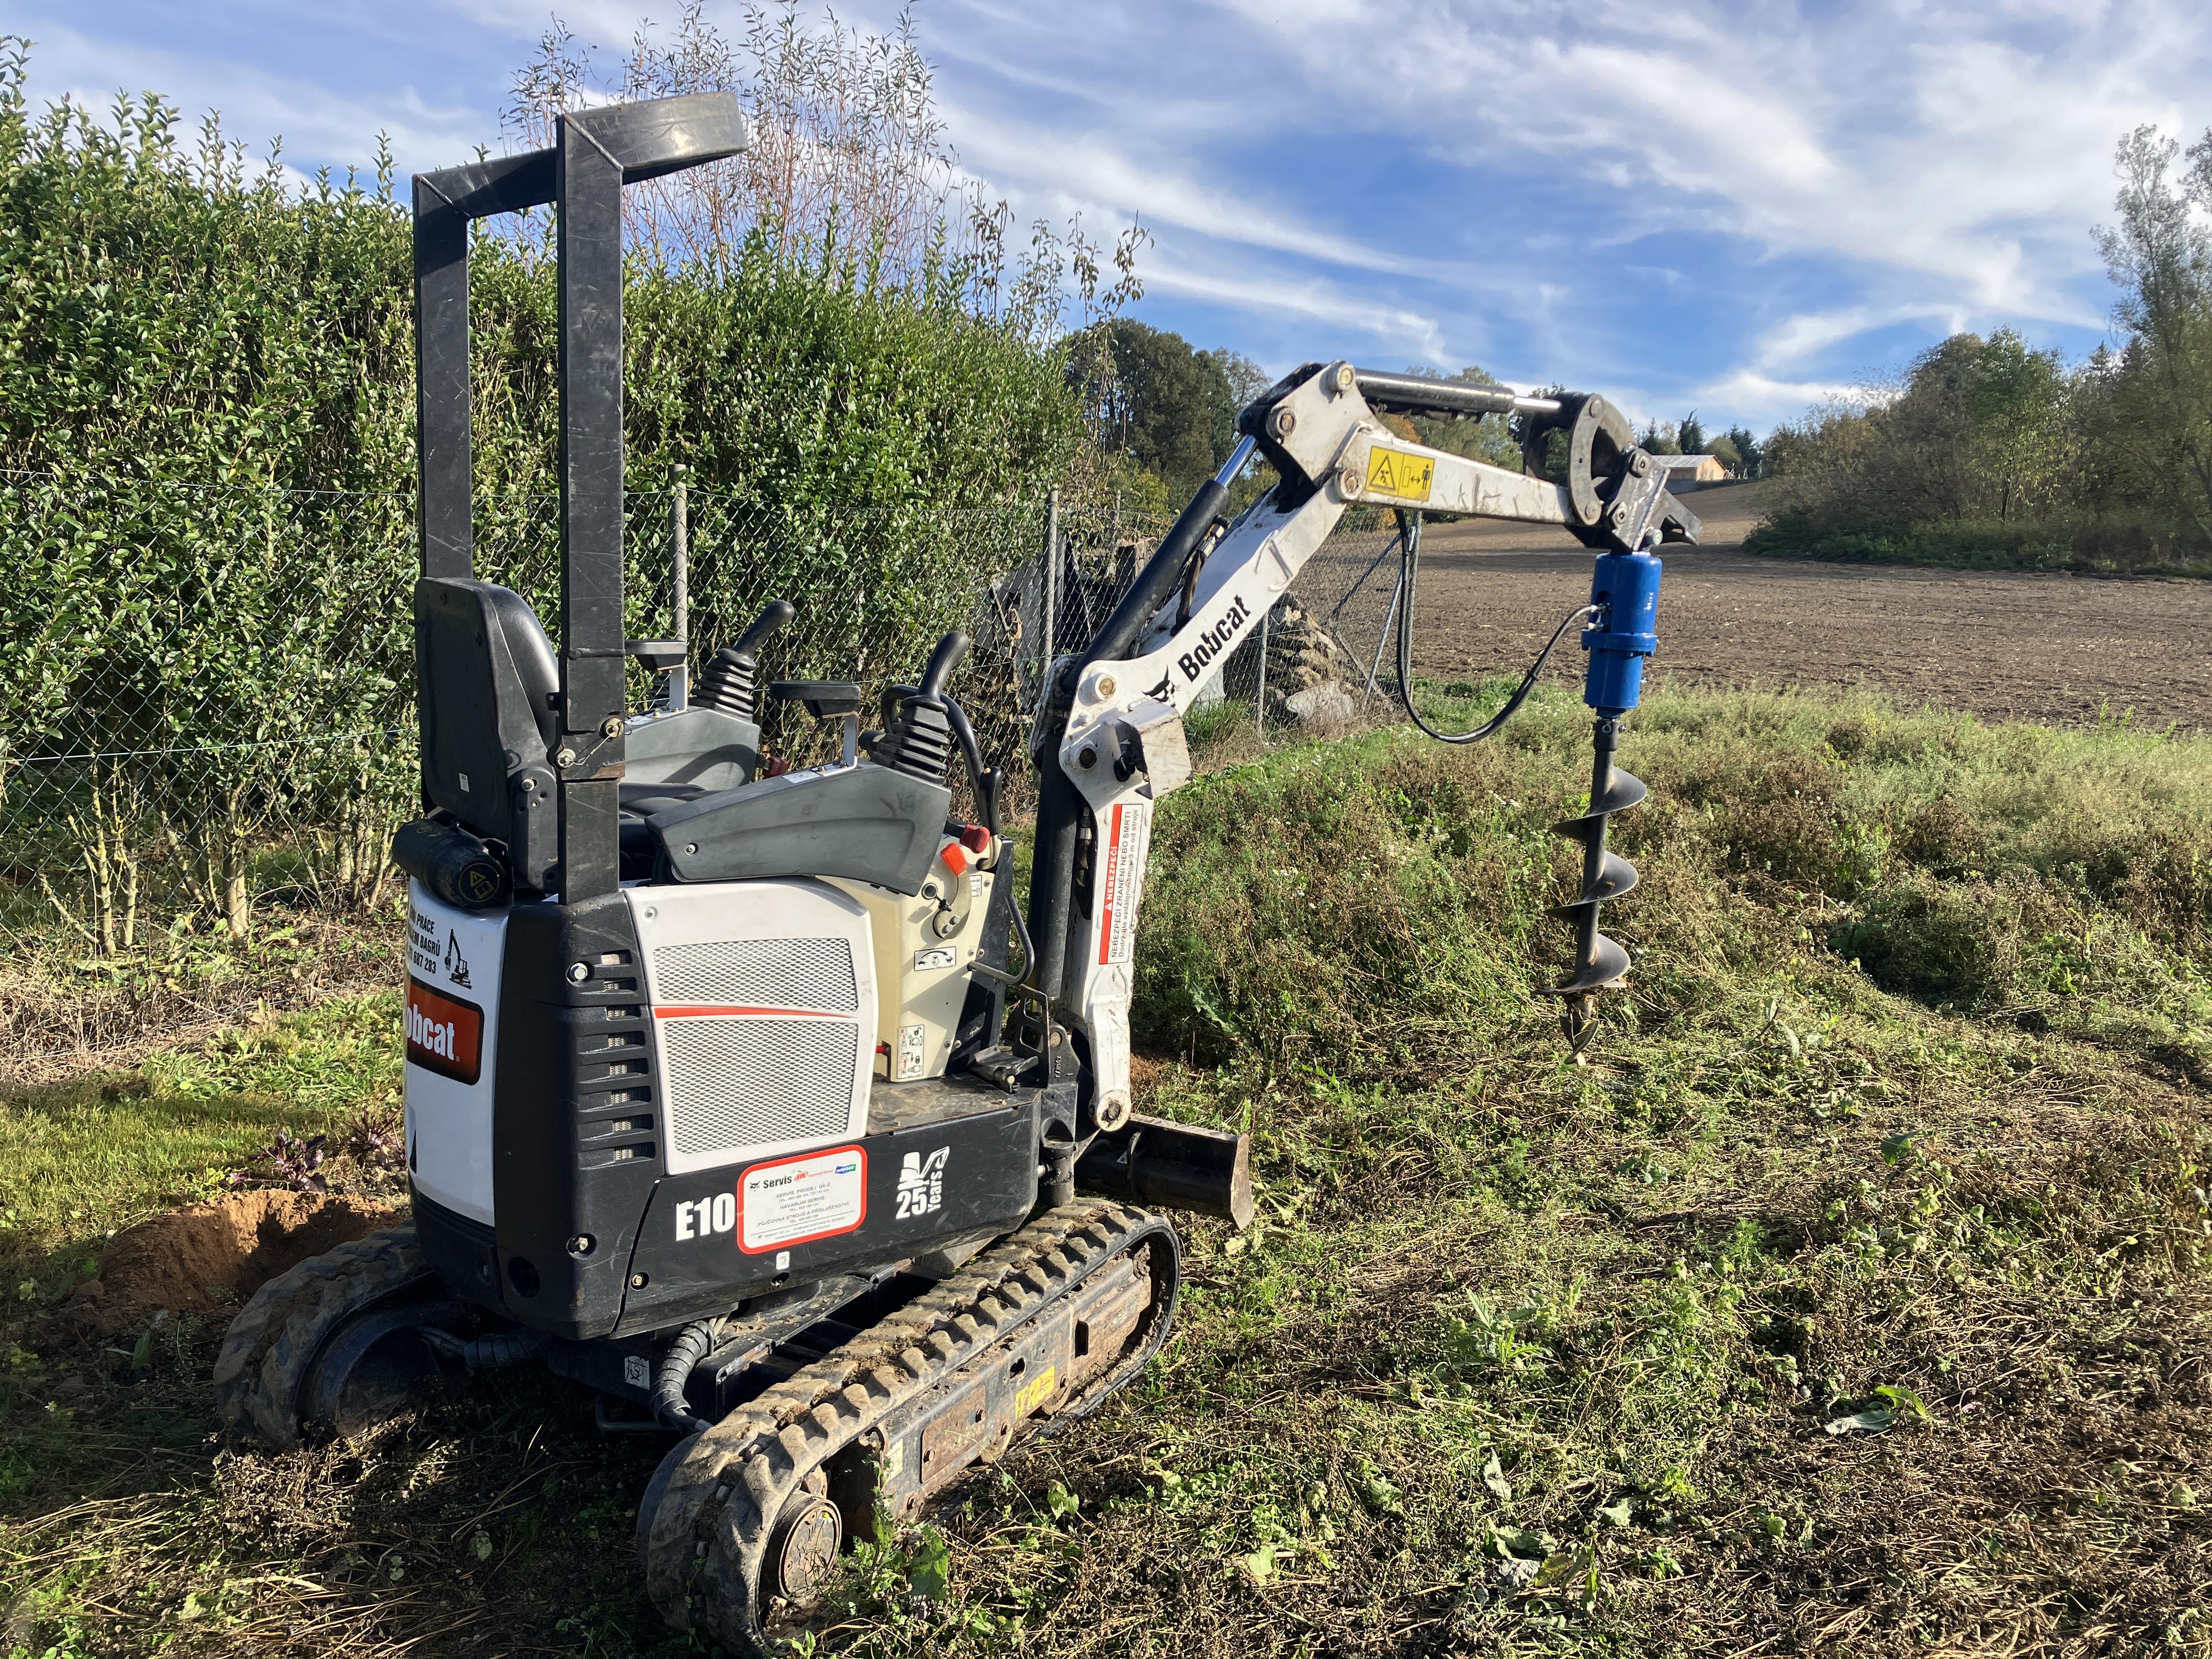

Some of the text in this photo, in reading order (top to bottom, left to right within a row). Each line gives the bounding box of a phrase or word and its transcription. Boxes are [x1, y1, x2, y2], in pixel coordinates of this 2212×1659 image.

[1177, 593, 1251, 683] Bobcat
[1130, 833, 1136, 843] od
[1107, 846, 1118, 900] NEBEZPEČÍ
[416, 913, 435, 935] PRÁCE
[1111, 909, 1121, 958] NEBEZPEČÍ
[413, 951, 424, 967] 687
[424, 957, 436, 974] 283
[420, 935, 440, 957] BAGRŮ
[405, 1003, 455, 1060] obcat
[763, 1175, 792, 1189] Servis
[796, 1185, 817, 1193] PRODEJ
[896, 1170, 943, 1219] 25 Years
[675, 1192, 735, 1241] E10
